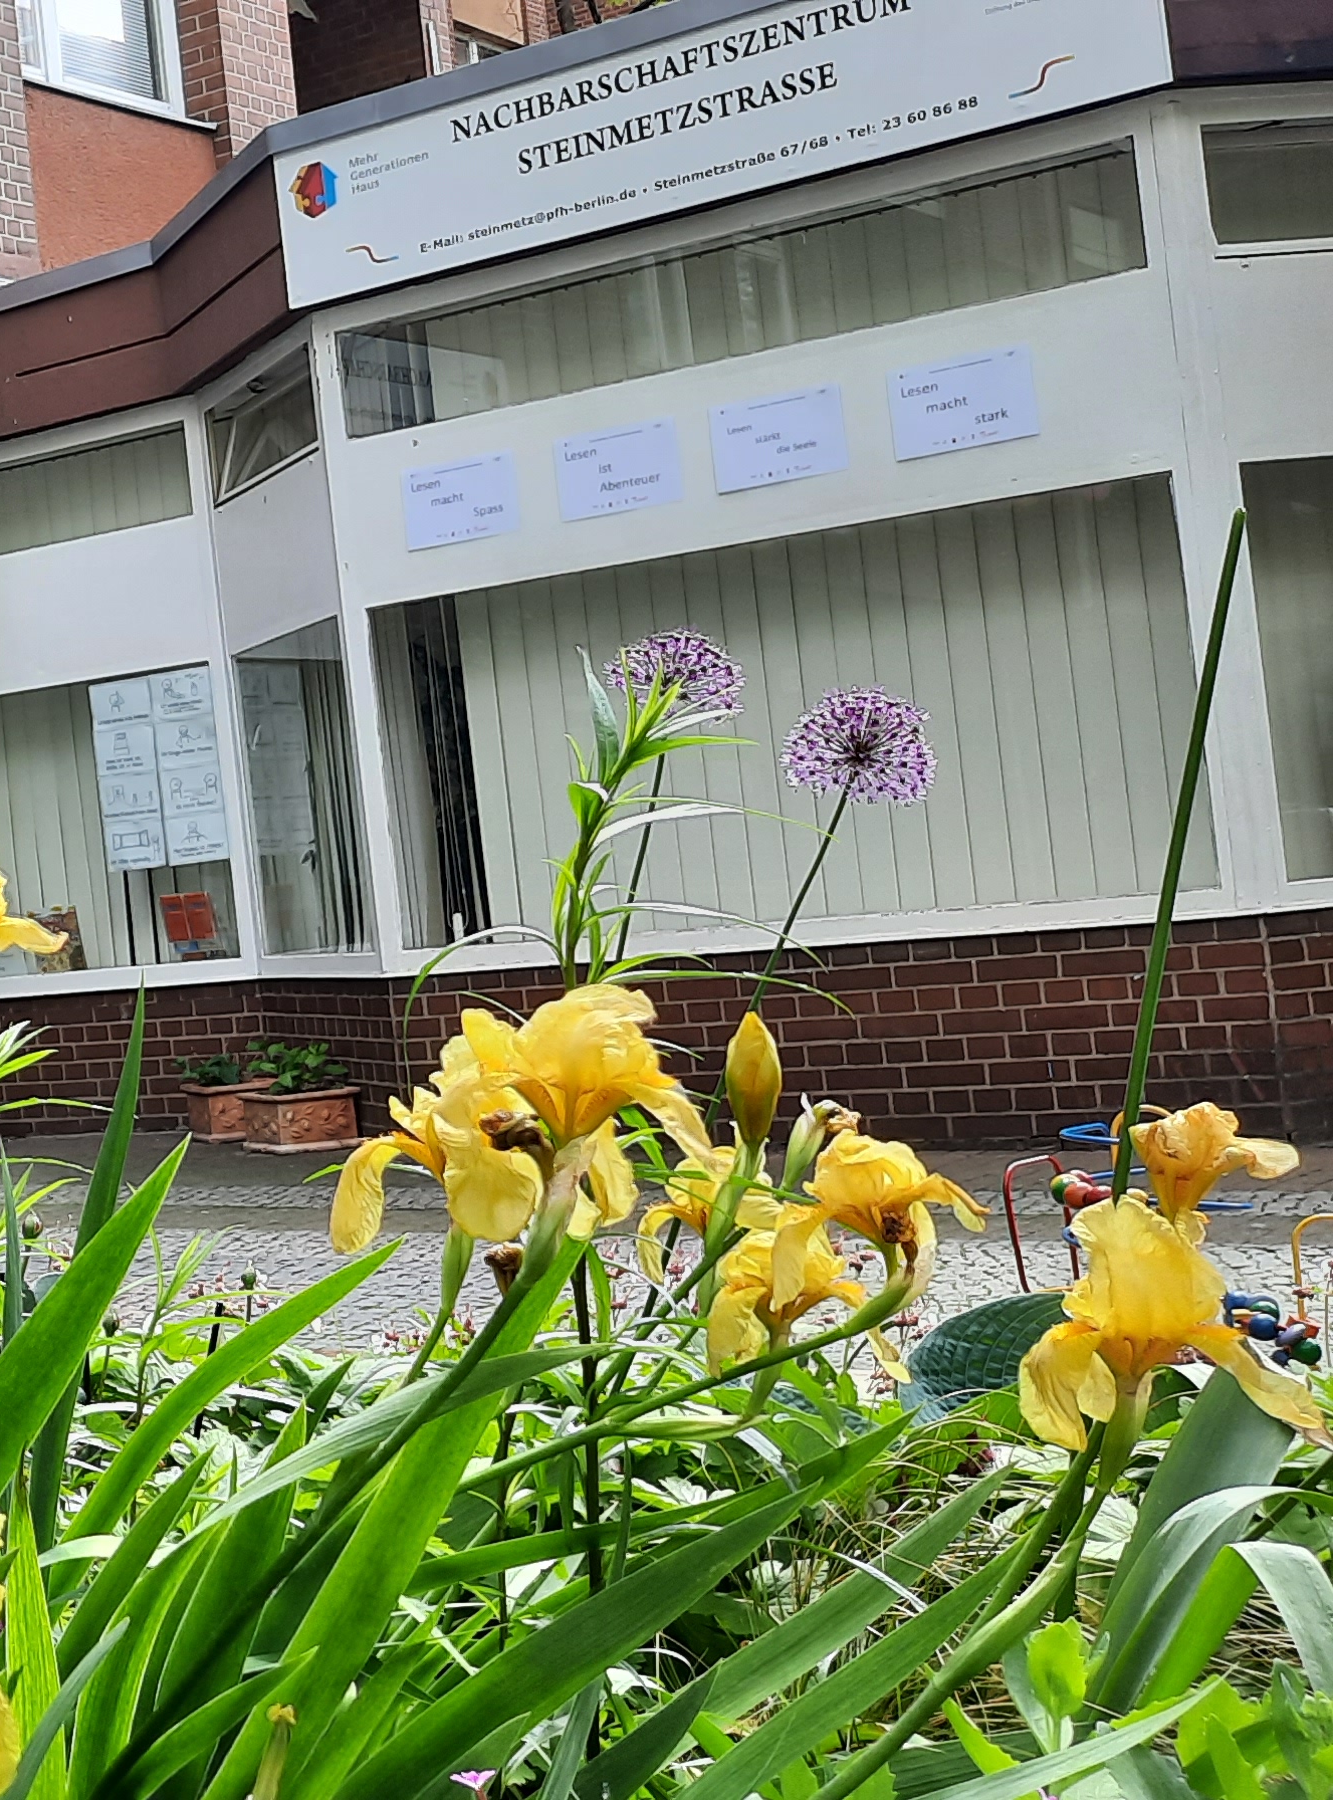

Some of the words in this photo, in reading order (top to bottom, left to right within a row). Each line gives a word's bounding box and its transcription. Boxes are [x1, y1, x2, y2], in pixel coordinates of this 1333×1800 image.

[517, 61, 839, 175] STEINMETZSTRASSE
[348, 152, 379, 168] Mehr
[350, 150, 430, 181] Generationen
[468, 188, 637, 241] steinmetz@pfh-berlin.de
[653, 150, 776, 192] Steinmetzstraße
[780, 134, 829, 159] 67/68
[847, 123, 877, 140] Tel:
[882, 116, 902, 132] 23
[907, 109, 927, 124] 60
[932, 102, 953, 117] 86
[957, 96, 978, 111] 88
[899, 381, 939, 399] Lesen
[925, 396, 969, 415] macht
[974, 408, 1009, 426] stark
[726, 424, 753, 436] Lesen
[564, 449, 597, 463] Lesen
[598, 463, 613, 474] ist
[410, 479, 441, 493] Lesen
[599, 472, 661, 493] Abenteuer
[430, 492, 464, 507] macht
[472, 504, 504, 518] Spass
